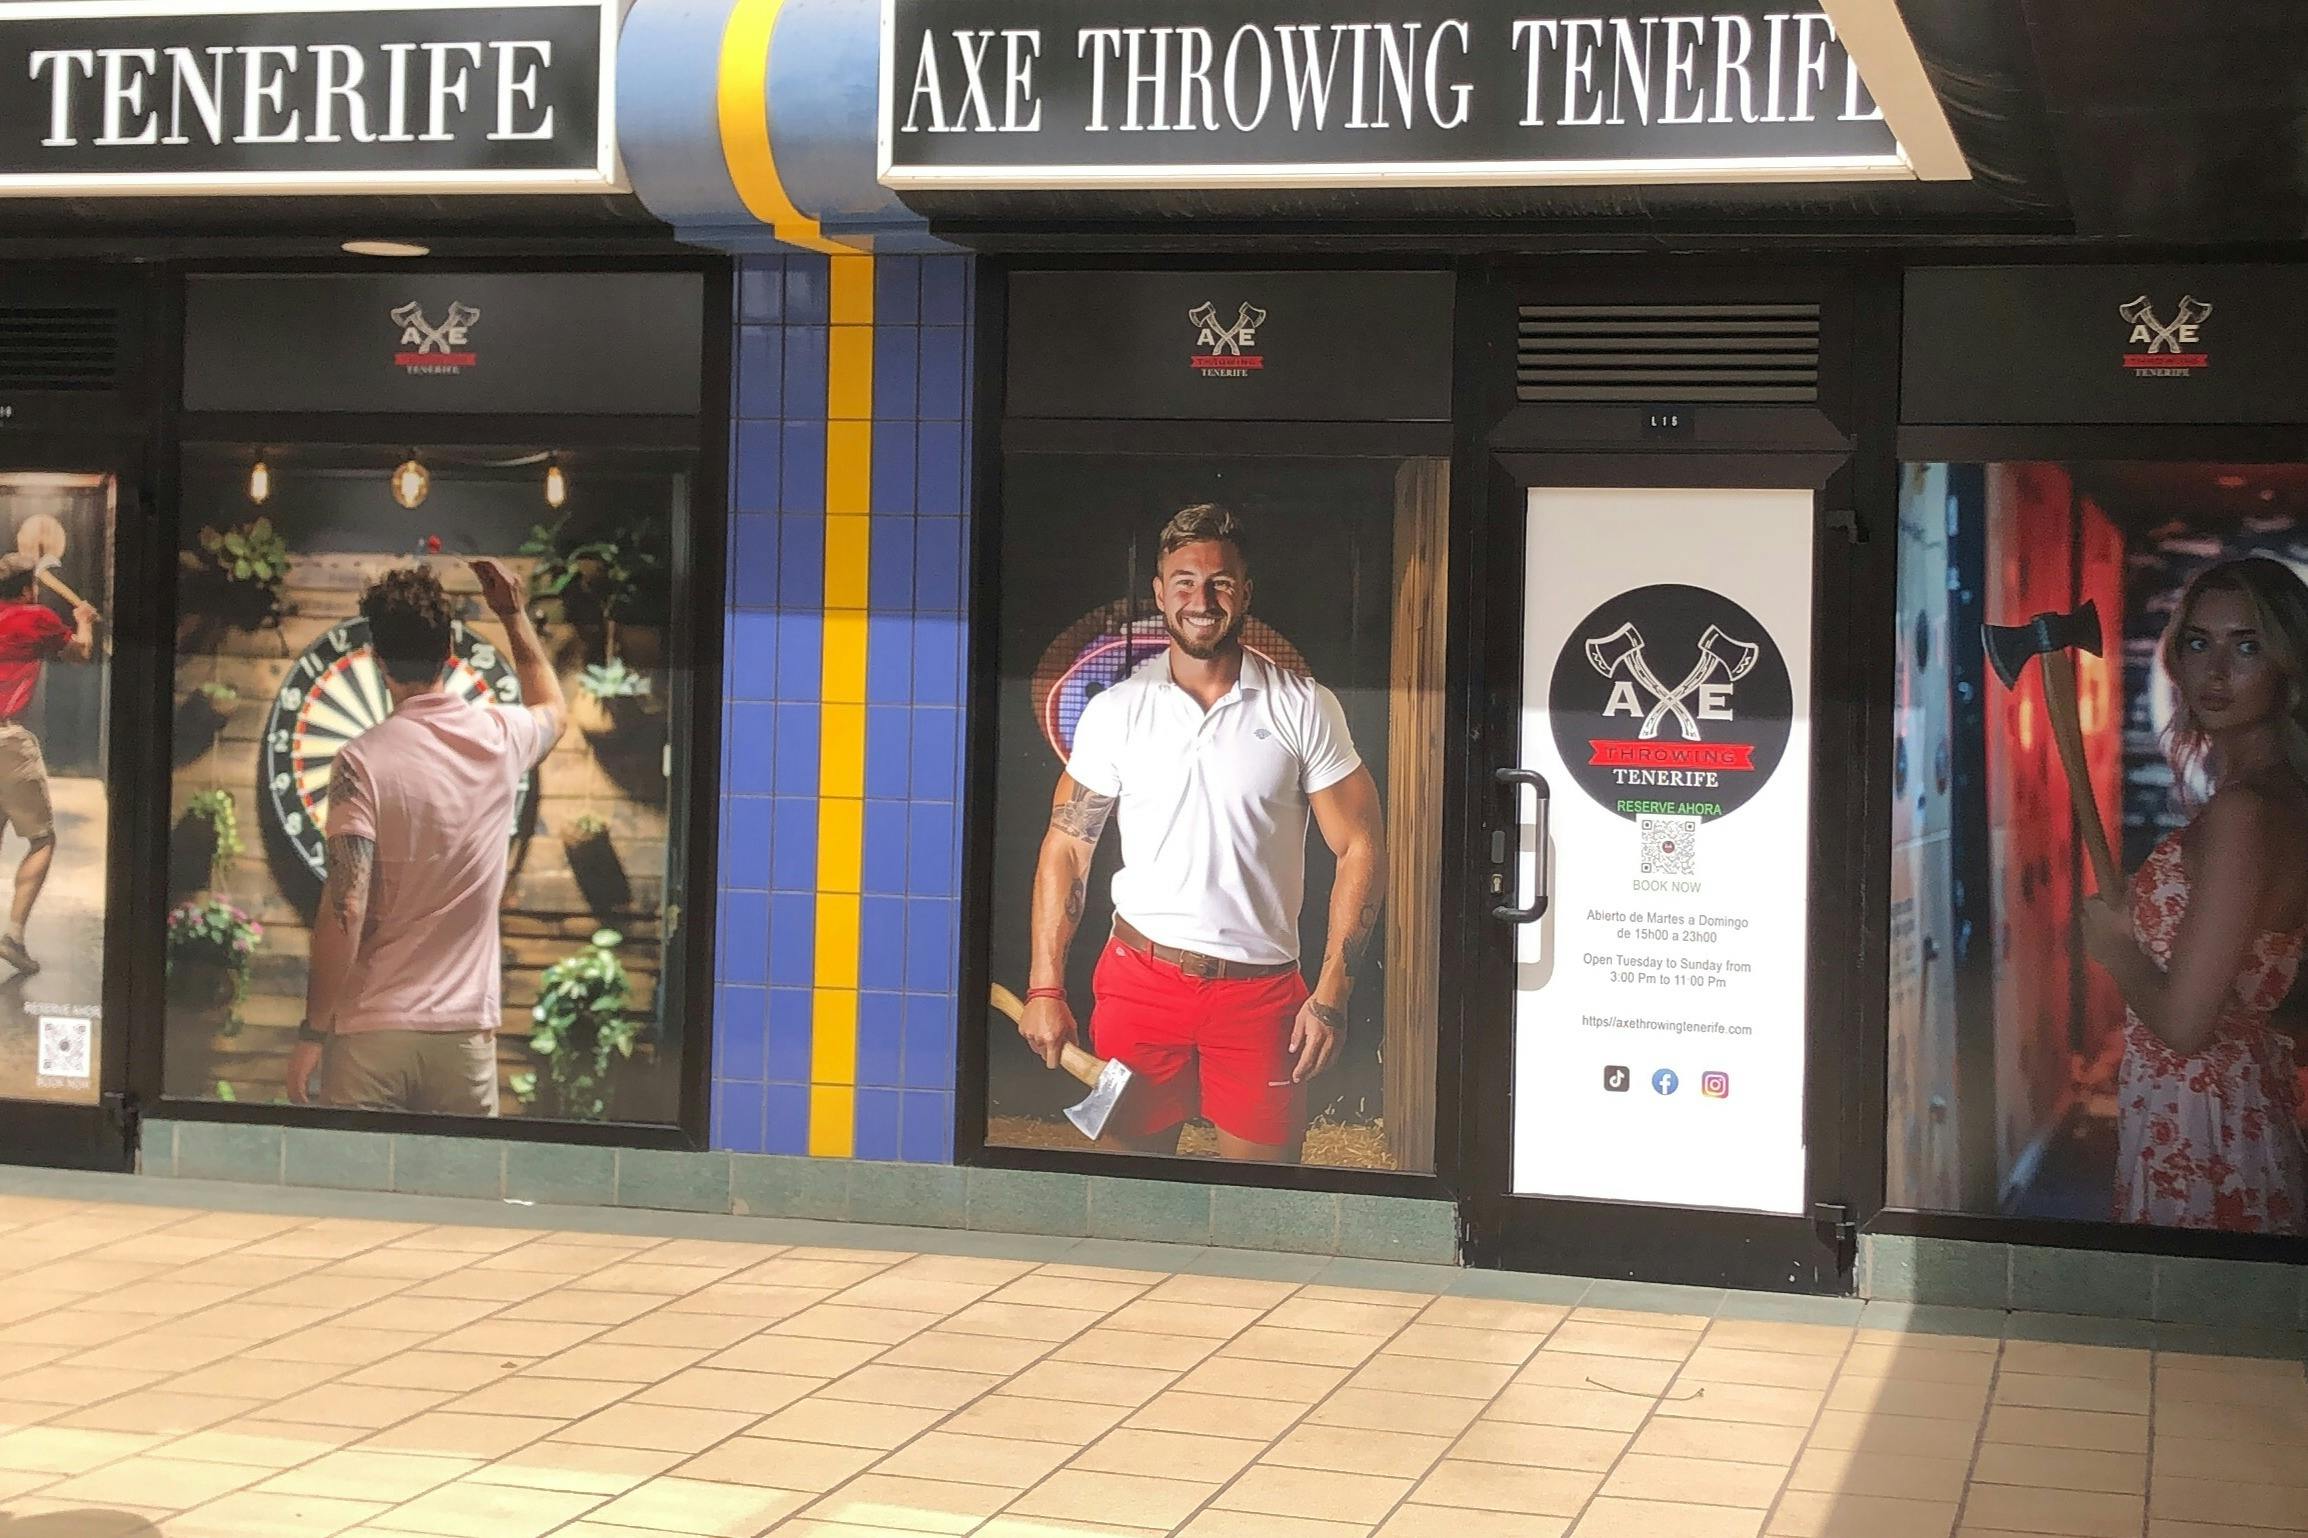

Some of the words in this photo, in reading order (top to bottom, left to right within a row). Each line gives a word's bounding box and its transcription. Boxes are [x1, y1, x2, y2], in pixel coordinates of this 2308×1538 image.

[901, 28, 1042, 133] AXE
[1077, 19, 1475, 132] THROWING
[29, 40, 555, 147] TENERIFE
[1201, 368, 1248, 377] TENERIFE
[1605, 747, 1736, 764] THROWING
[1613, 768, 1719, 788] TENERIFE
[1617, 800, 1676, 814] RESERVE
[1678, 802, 1722, 816] AHORA
[1633, 879, 1668, 891] BOOK
[1671, 881, 1702, 893] NOW
[1586, 909, 1627, 922] Abierto
[1629, 911, 1644, 923] de
[1646, 911, 1685, 925] Martes
[1688, 916, 1696, 925] a
[1698, 914, 1749, 931] Domingo
[1616, 927, 1631, 939] de
[1635, 928, 1669, 941] 15h00
[1672, 932, 1679, 941] a
[1682, 930, 1718, 943] 23h00
[1583, 952, 1613, 967] Open
[1615, 954, 1664, 971] Tuesday
[1666, 957, 1677, 969] to
[1680, 957, 1723, 973] Sunday
[1726, 959, 1752, 972] from
[1610, 970, 1635, 983] 3:00
[1638, 972, 1657, 984] Pm
[1660, 973, 1671, 985] to
[1707, 975, 1727, 988] Pm
